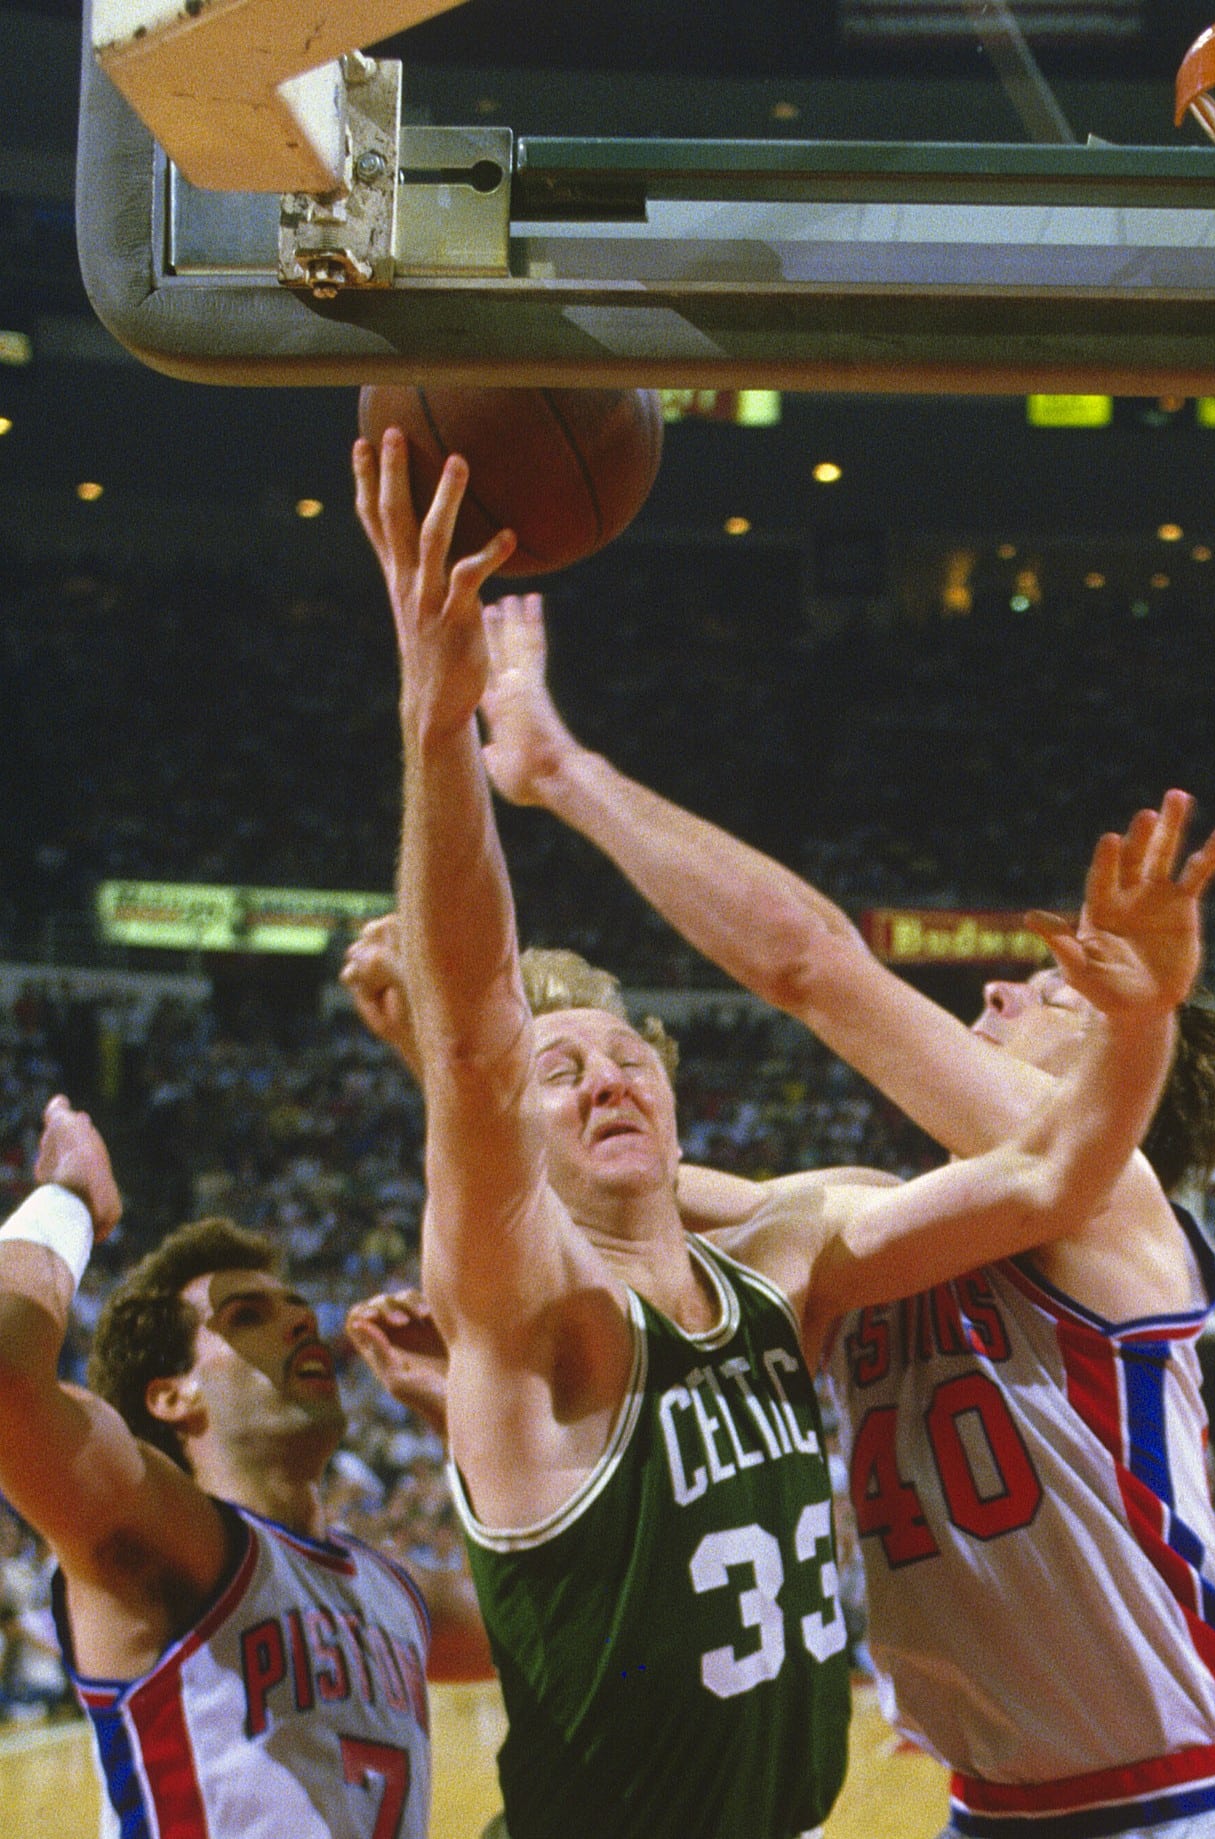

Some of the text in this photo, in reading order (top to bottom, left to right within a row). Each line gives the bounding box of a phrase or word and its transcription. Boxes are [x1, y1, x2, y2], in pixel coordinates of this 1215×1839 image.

[659, 1347, 825, 1507] CELTIC
[850, 1370, 1043, 1570] 40
[689, 1498, 848, 1699] 33
[338, 1733, 411, 1839] 7
